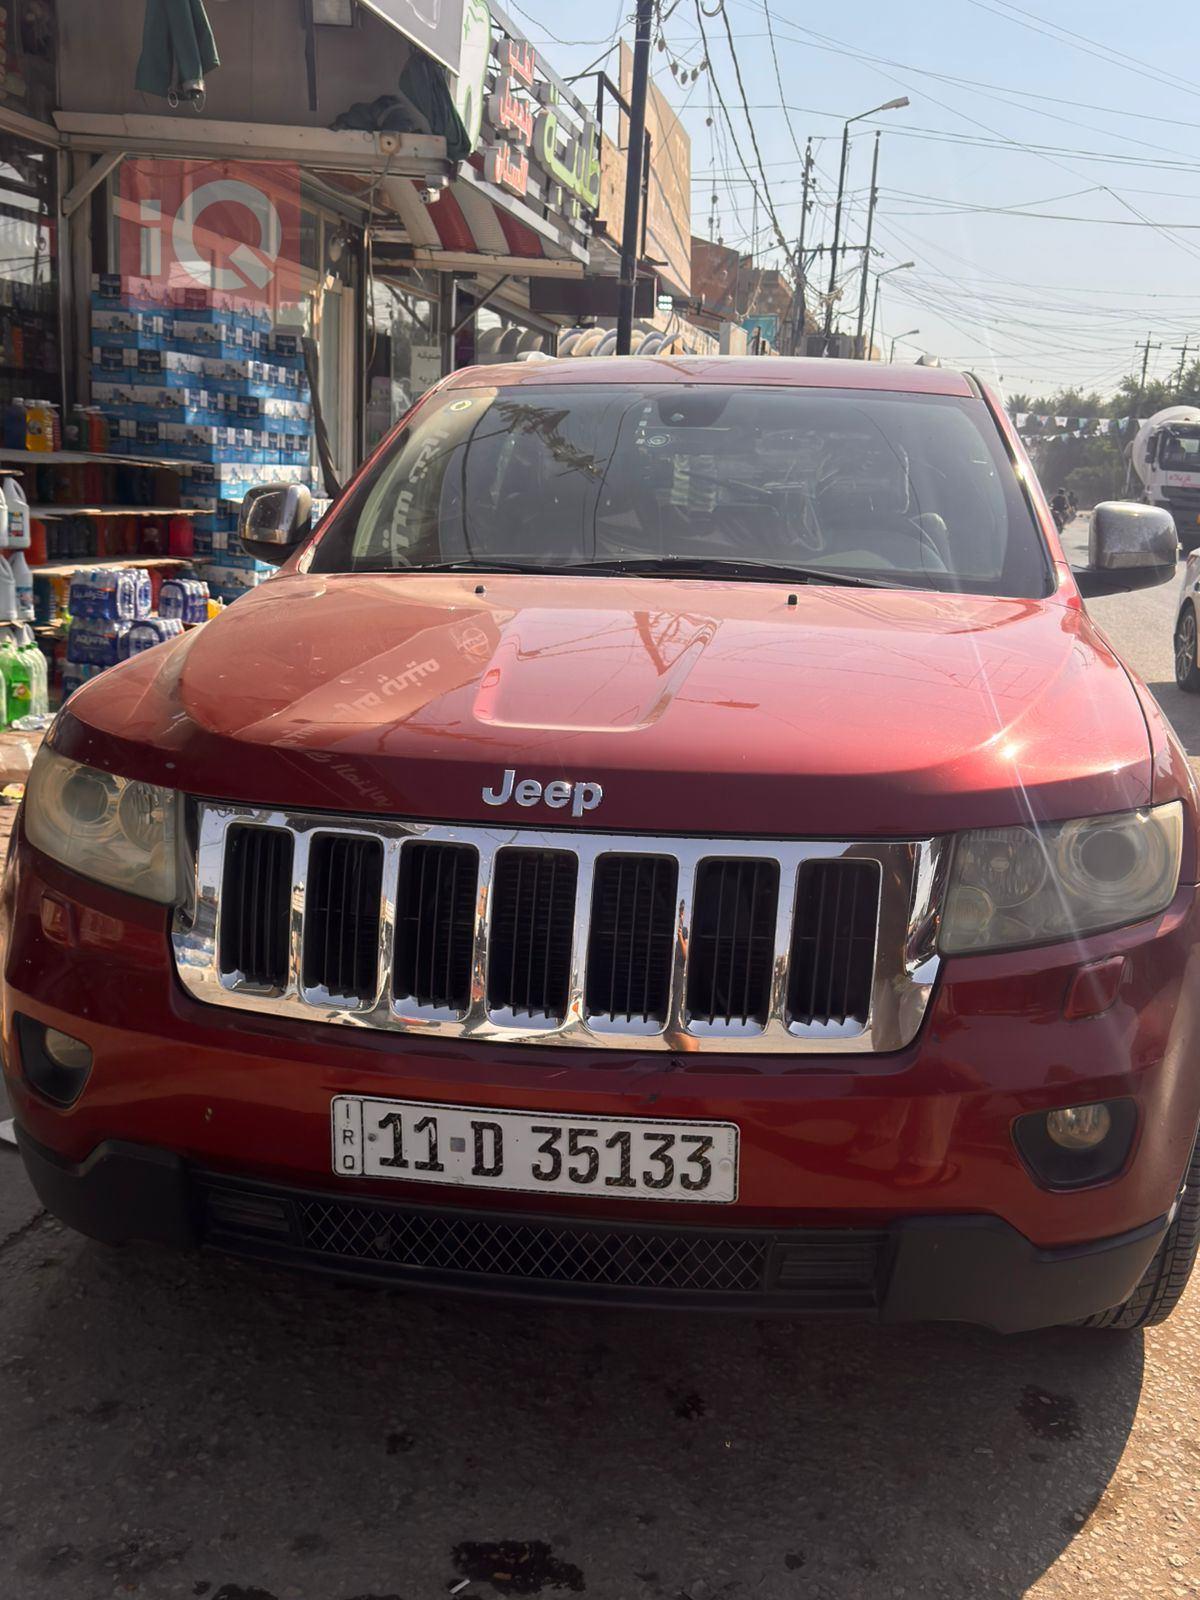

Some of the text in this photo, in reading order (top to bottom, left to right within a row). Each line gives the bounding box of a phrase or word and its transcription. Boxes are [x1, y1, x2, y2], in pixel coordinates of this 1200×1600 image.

[481, 769, 604, 818] Jeep
[378, 1112, 445, 1173] 11
[470, 1120, 504, 1177] D
[530, 1125, 715, 1191] 35133
